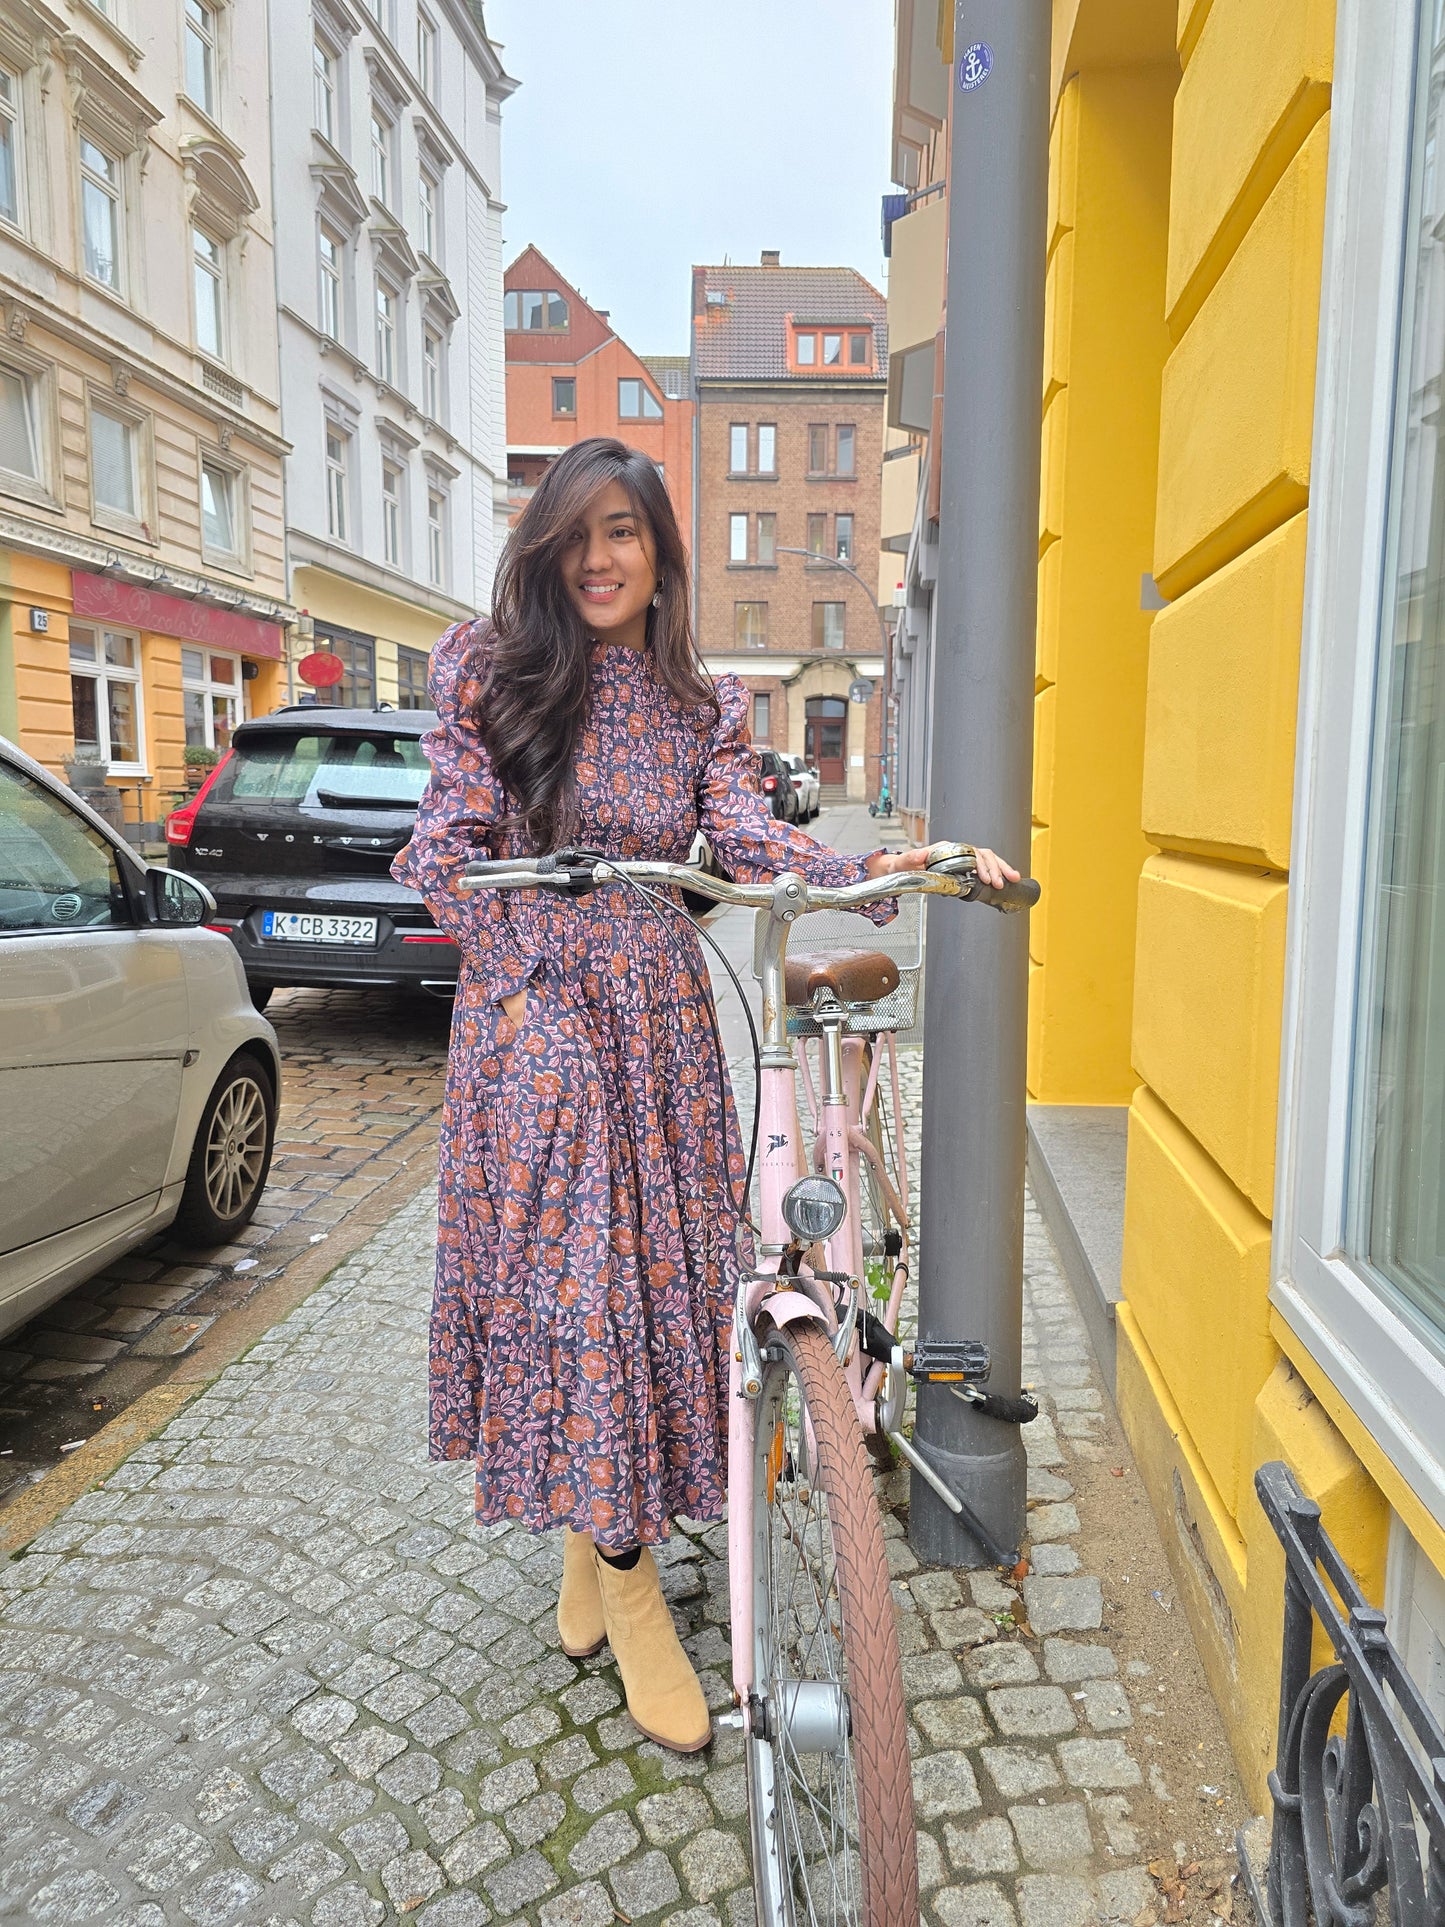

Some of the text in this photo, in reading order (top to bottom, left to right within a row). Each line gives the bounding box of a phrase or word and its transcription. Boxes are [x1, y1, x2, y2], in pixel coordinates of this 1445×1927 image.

[963, 43, 981, 60] HAFEN
[37, 614, 48, 628] 25
[256, 833, 381, 847] VOLVO
[275, 916, 374, 939] K CB 3322
